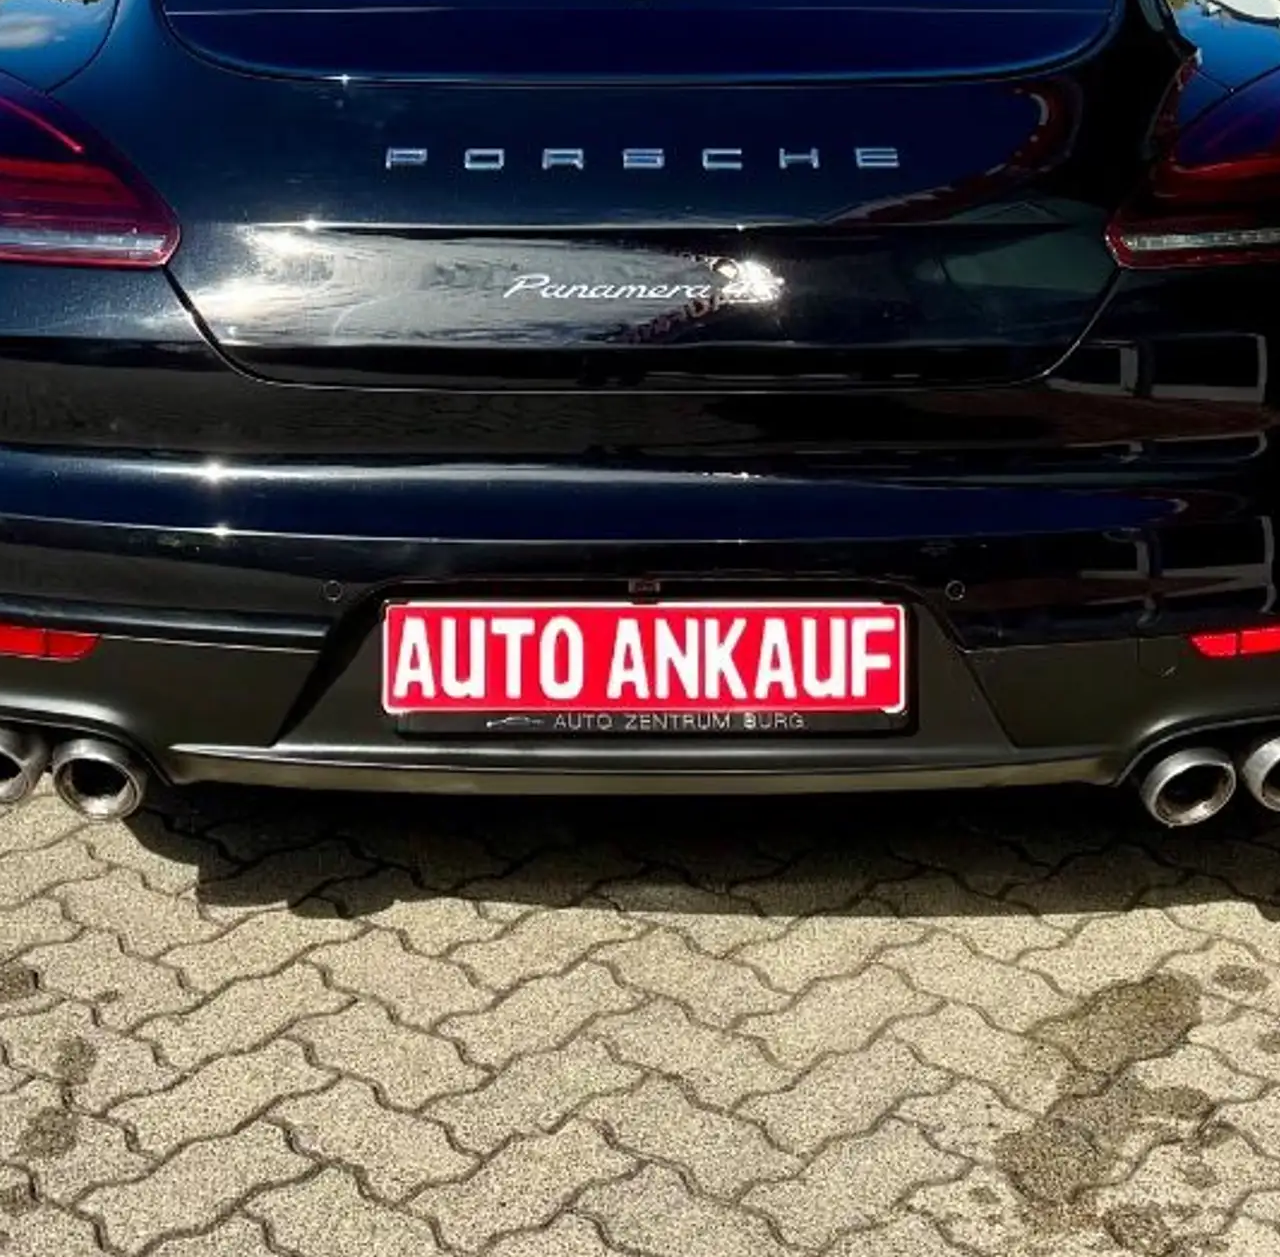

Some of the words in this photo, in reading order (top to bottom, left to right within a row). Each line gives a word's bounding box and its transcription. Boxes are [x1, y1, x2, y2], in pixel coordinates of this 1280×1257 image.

[384, 146, 901, 171] PORSCHE
[503, 272, 712, 299] Panamera
[394, 616, 585, 700] AUTO
[605, 616, 896, 700] ANKAUF
[553, 715, 616, 730] AUTO
[624, 715, 731, 730] ZENTRUM
[742, 715, 804, 730] BURG
